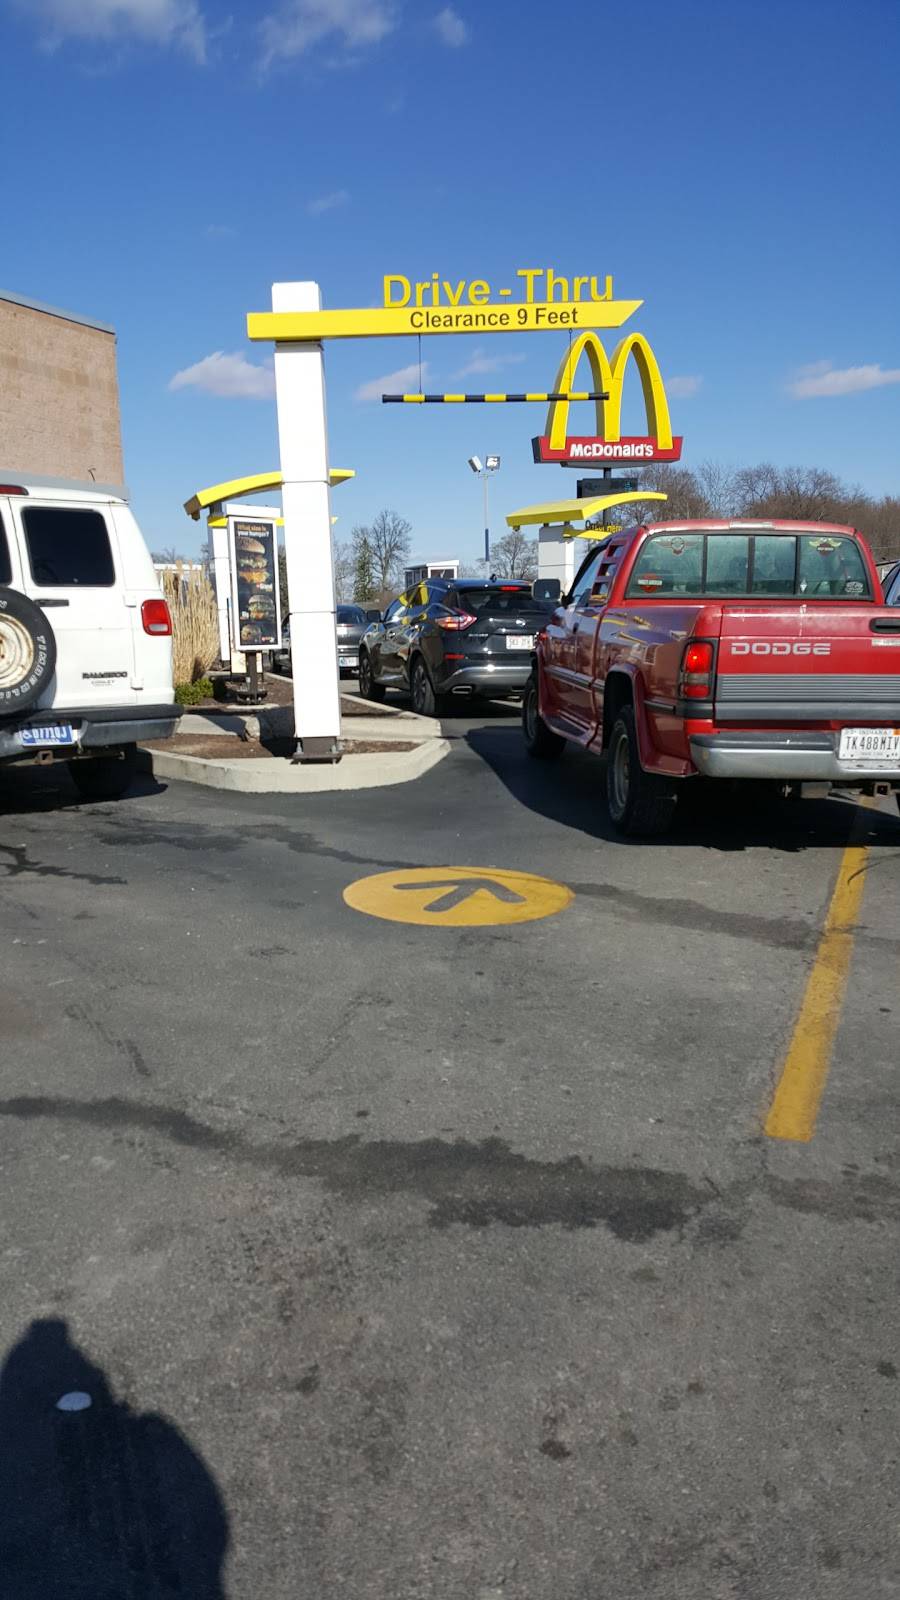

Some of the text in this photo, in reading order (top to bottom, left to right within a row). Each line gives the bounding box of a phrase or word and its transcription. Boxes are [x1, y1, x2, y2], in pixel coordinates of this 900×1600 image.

[383, 272, 491, 308] Drive
[517, 268, 614, 303] Thru
[410, 307, 579, 329] Clearance 9 Feet
[569, 443, 654, 458] McDonald's
[731, 642, 831, 656] DODGE
